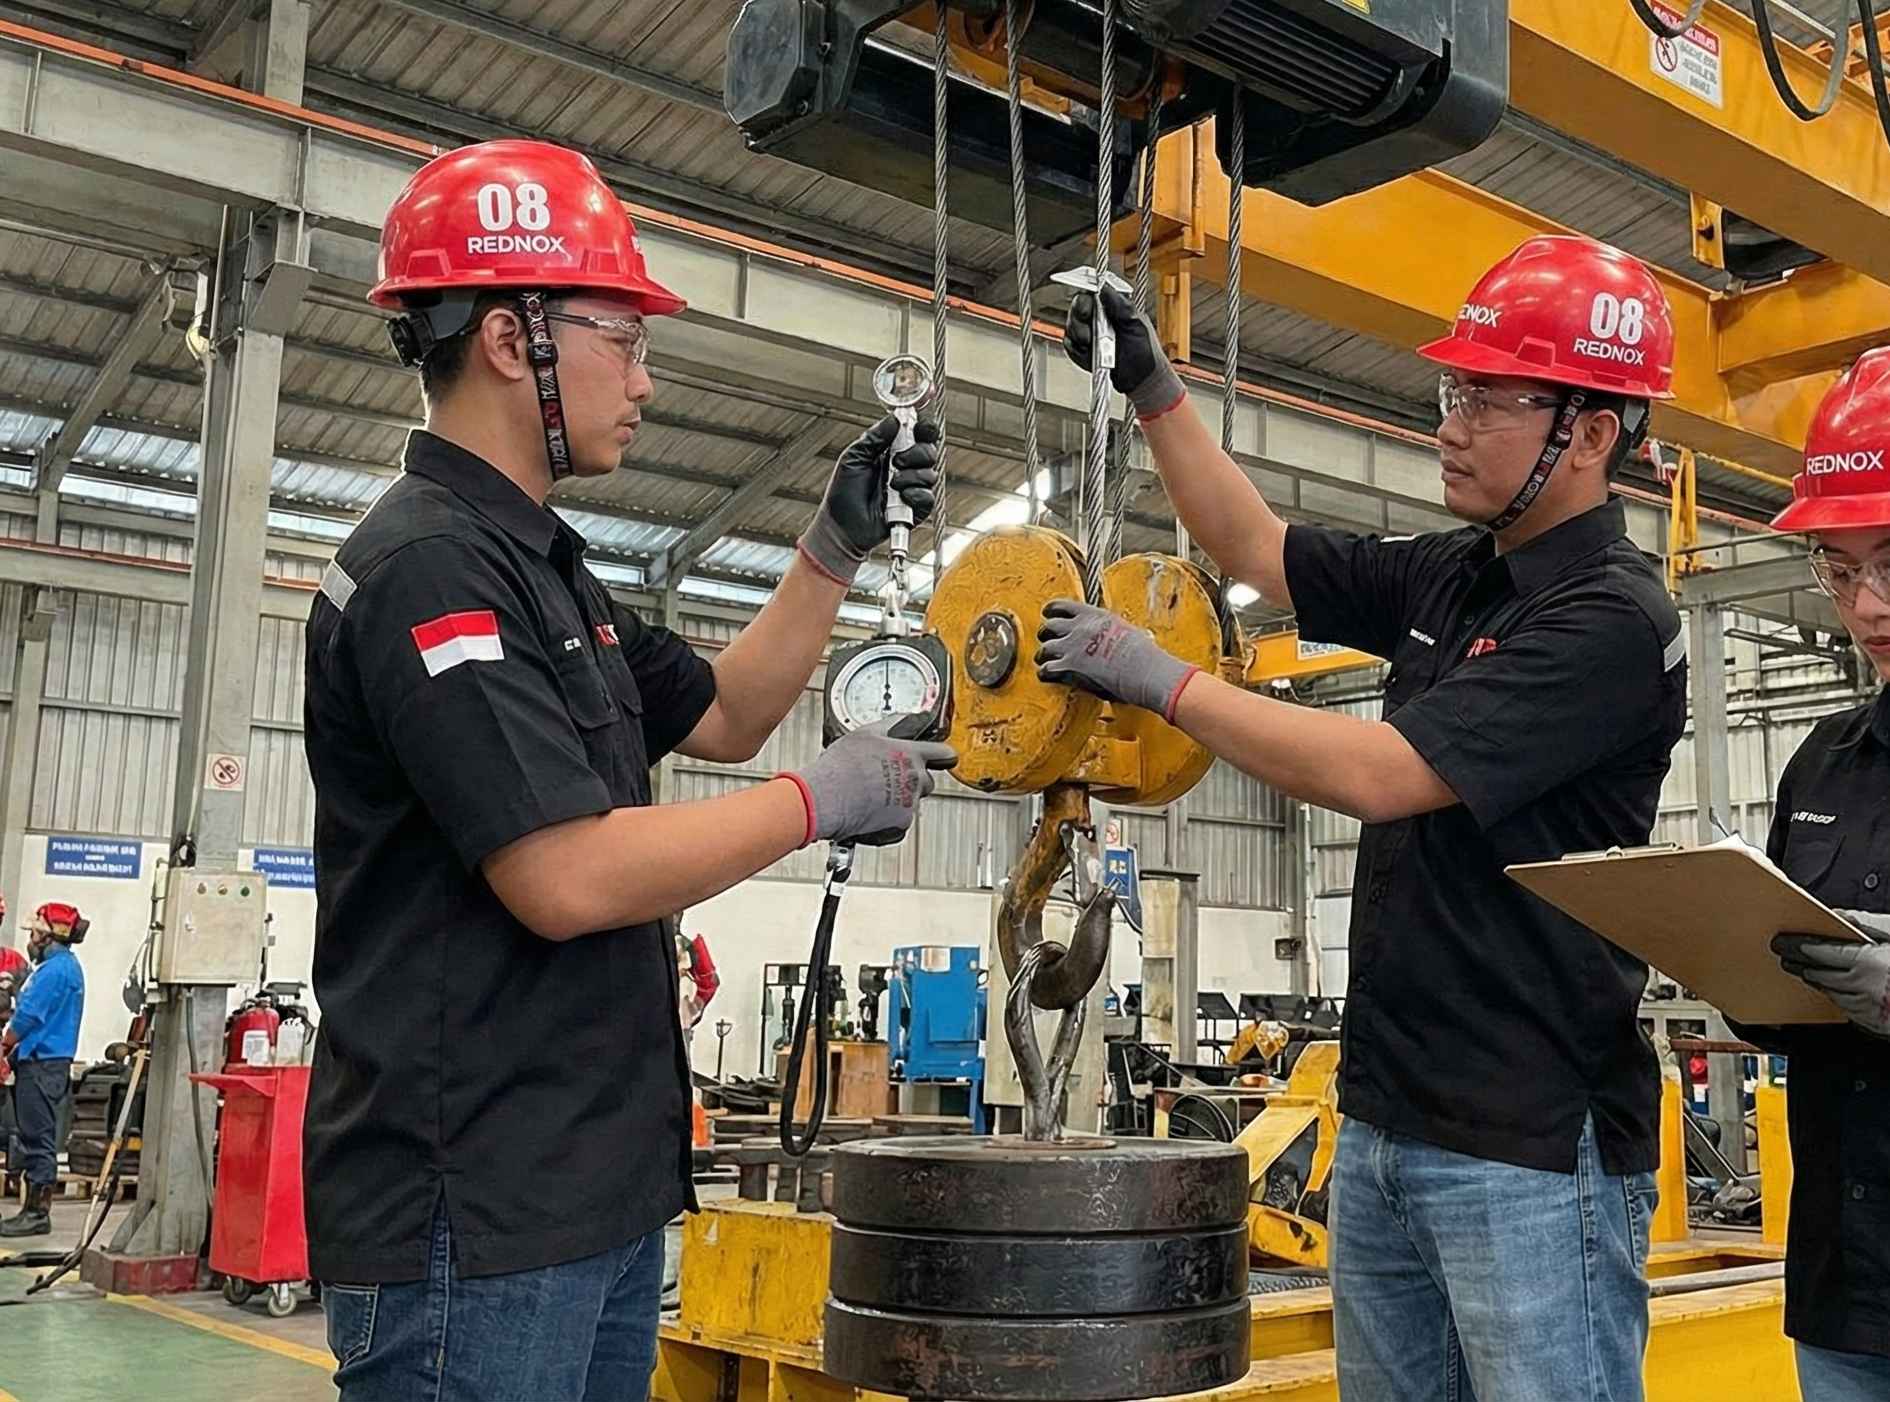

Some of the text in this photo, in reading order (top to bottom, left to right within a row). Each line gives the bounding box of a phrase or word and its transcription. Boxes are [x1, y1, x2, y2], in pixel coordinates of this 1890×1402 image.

[477, 183, 551, 231] 08
[467, 235, 567, 255] REDNOX
[1590, 292, 1645, 345] 08
[1573, 338, 1647, 366] REDNOX
[1806, 449, 1885, 476] REDNOX
